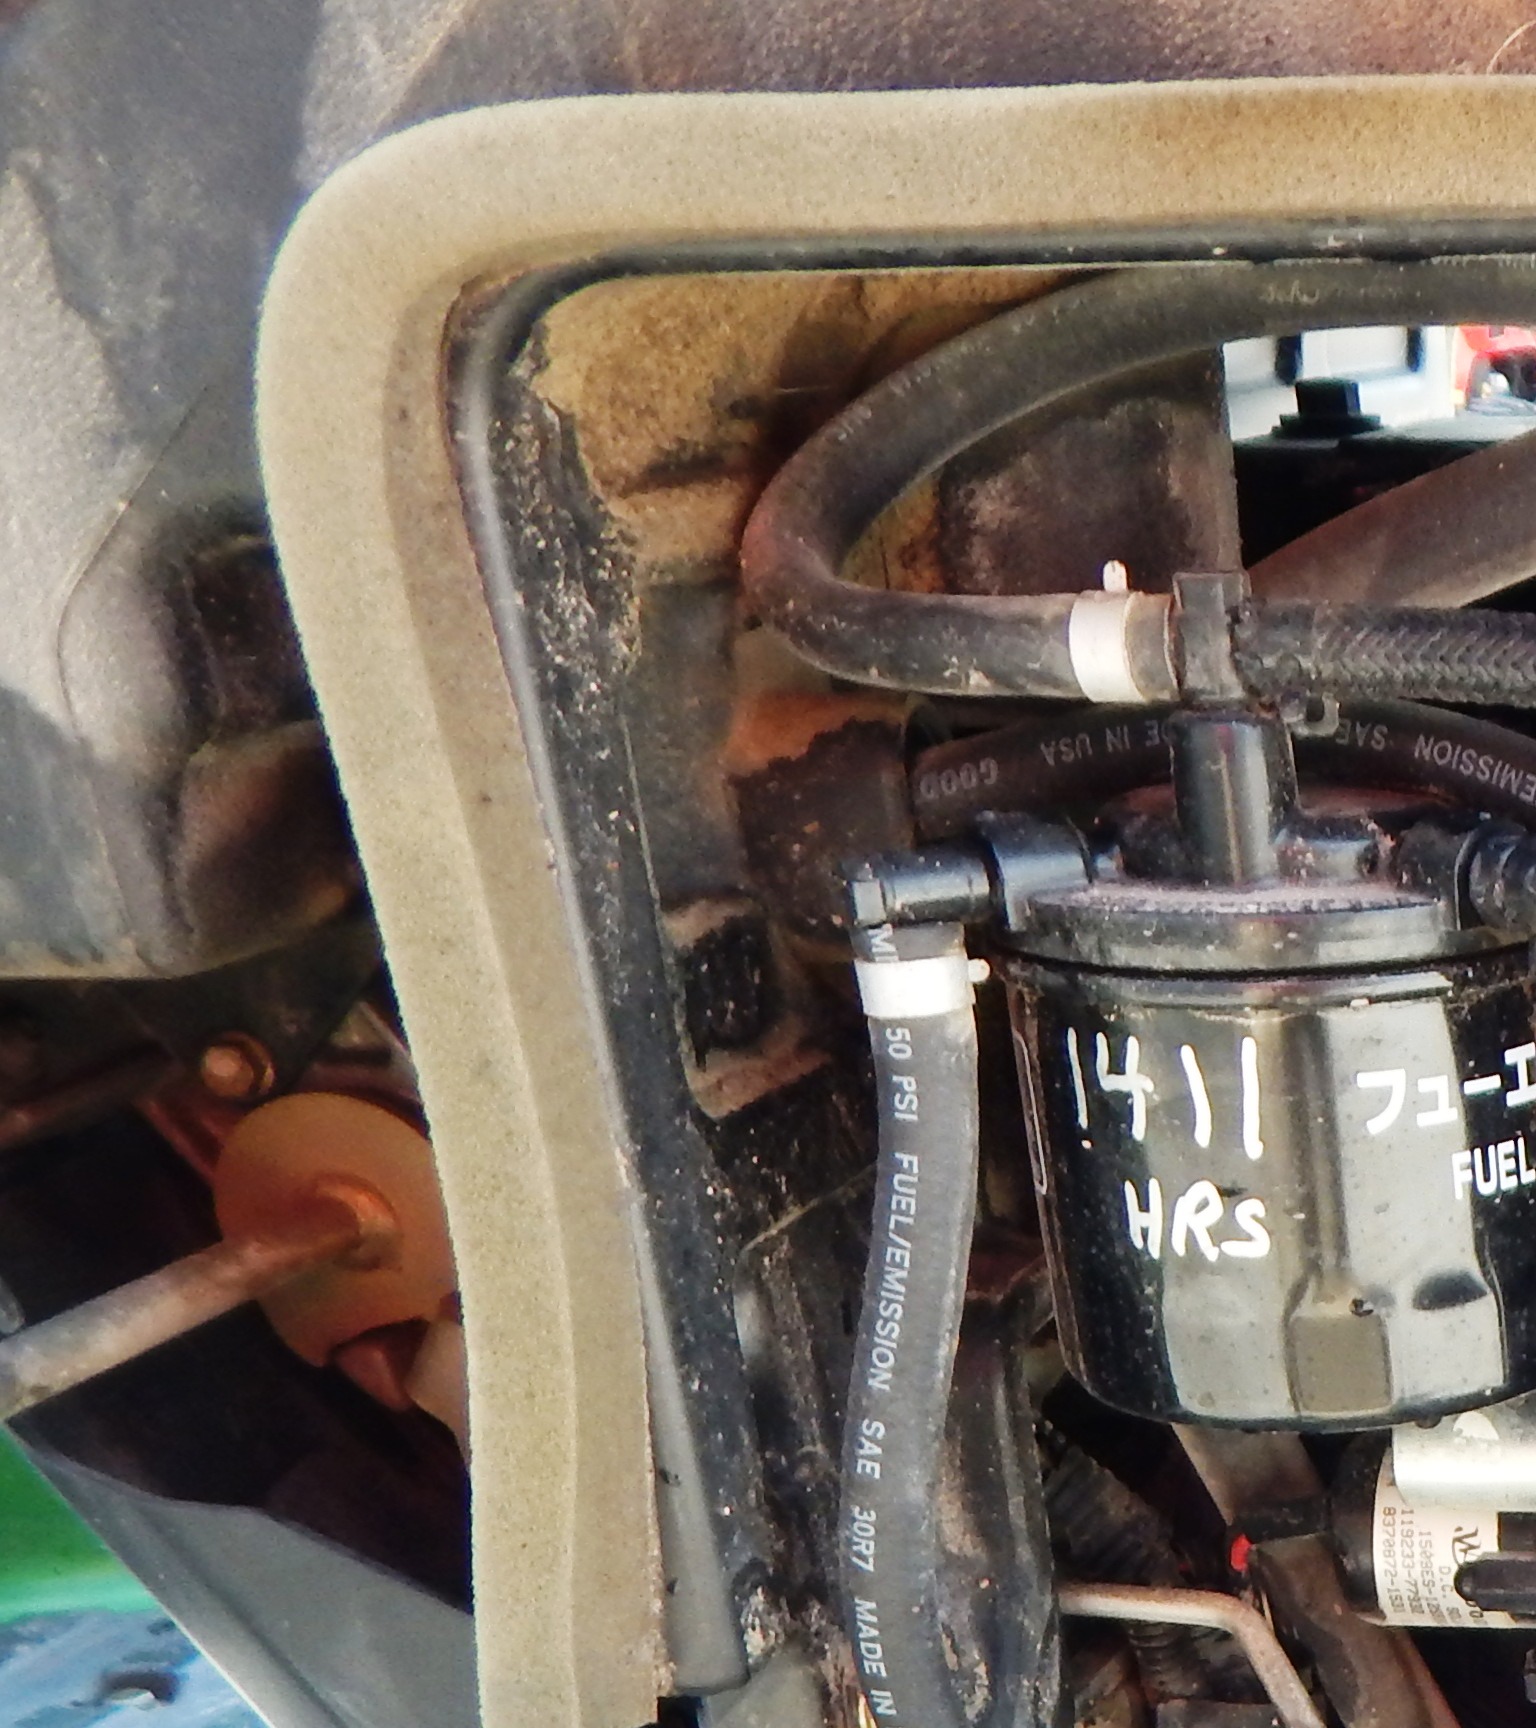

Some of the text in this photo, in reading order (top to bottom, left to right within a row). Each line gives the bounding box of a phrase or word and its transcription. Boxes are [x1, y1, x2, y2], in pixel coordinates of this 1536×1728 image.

[1040, 736, 1093, 767] USA
[1105, 724, 1131, 754] IN
[885, 1026, 913, 1060] 50
[890, 1073, 920, 1123] PSI
[1067, 1025, 1264, 1160] 1411
[868, 1150, 920, 1392] FUEL/EMISSION
[855, 1417, 886, 1480] SAE
[845, 1504, 877, 1574] 30R7
[852, 1596, 888, 1678] MADE
[868, 1686, 898, 1718] IN
